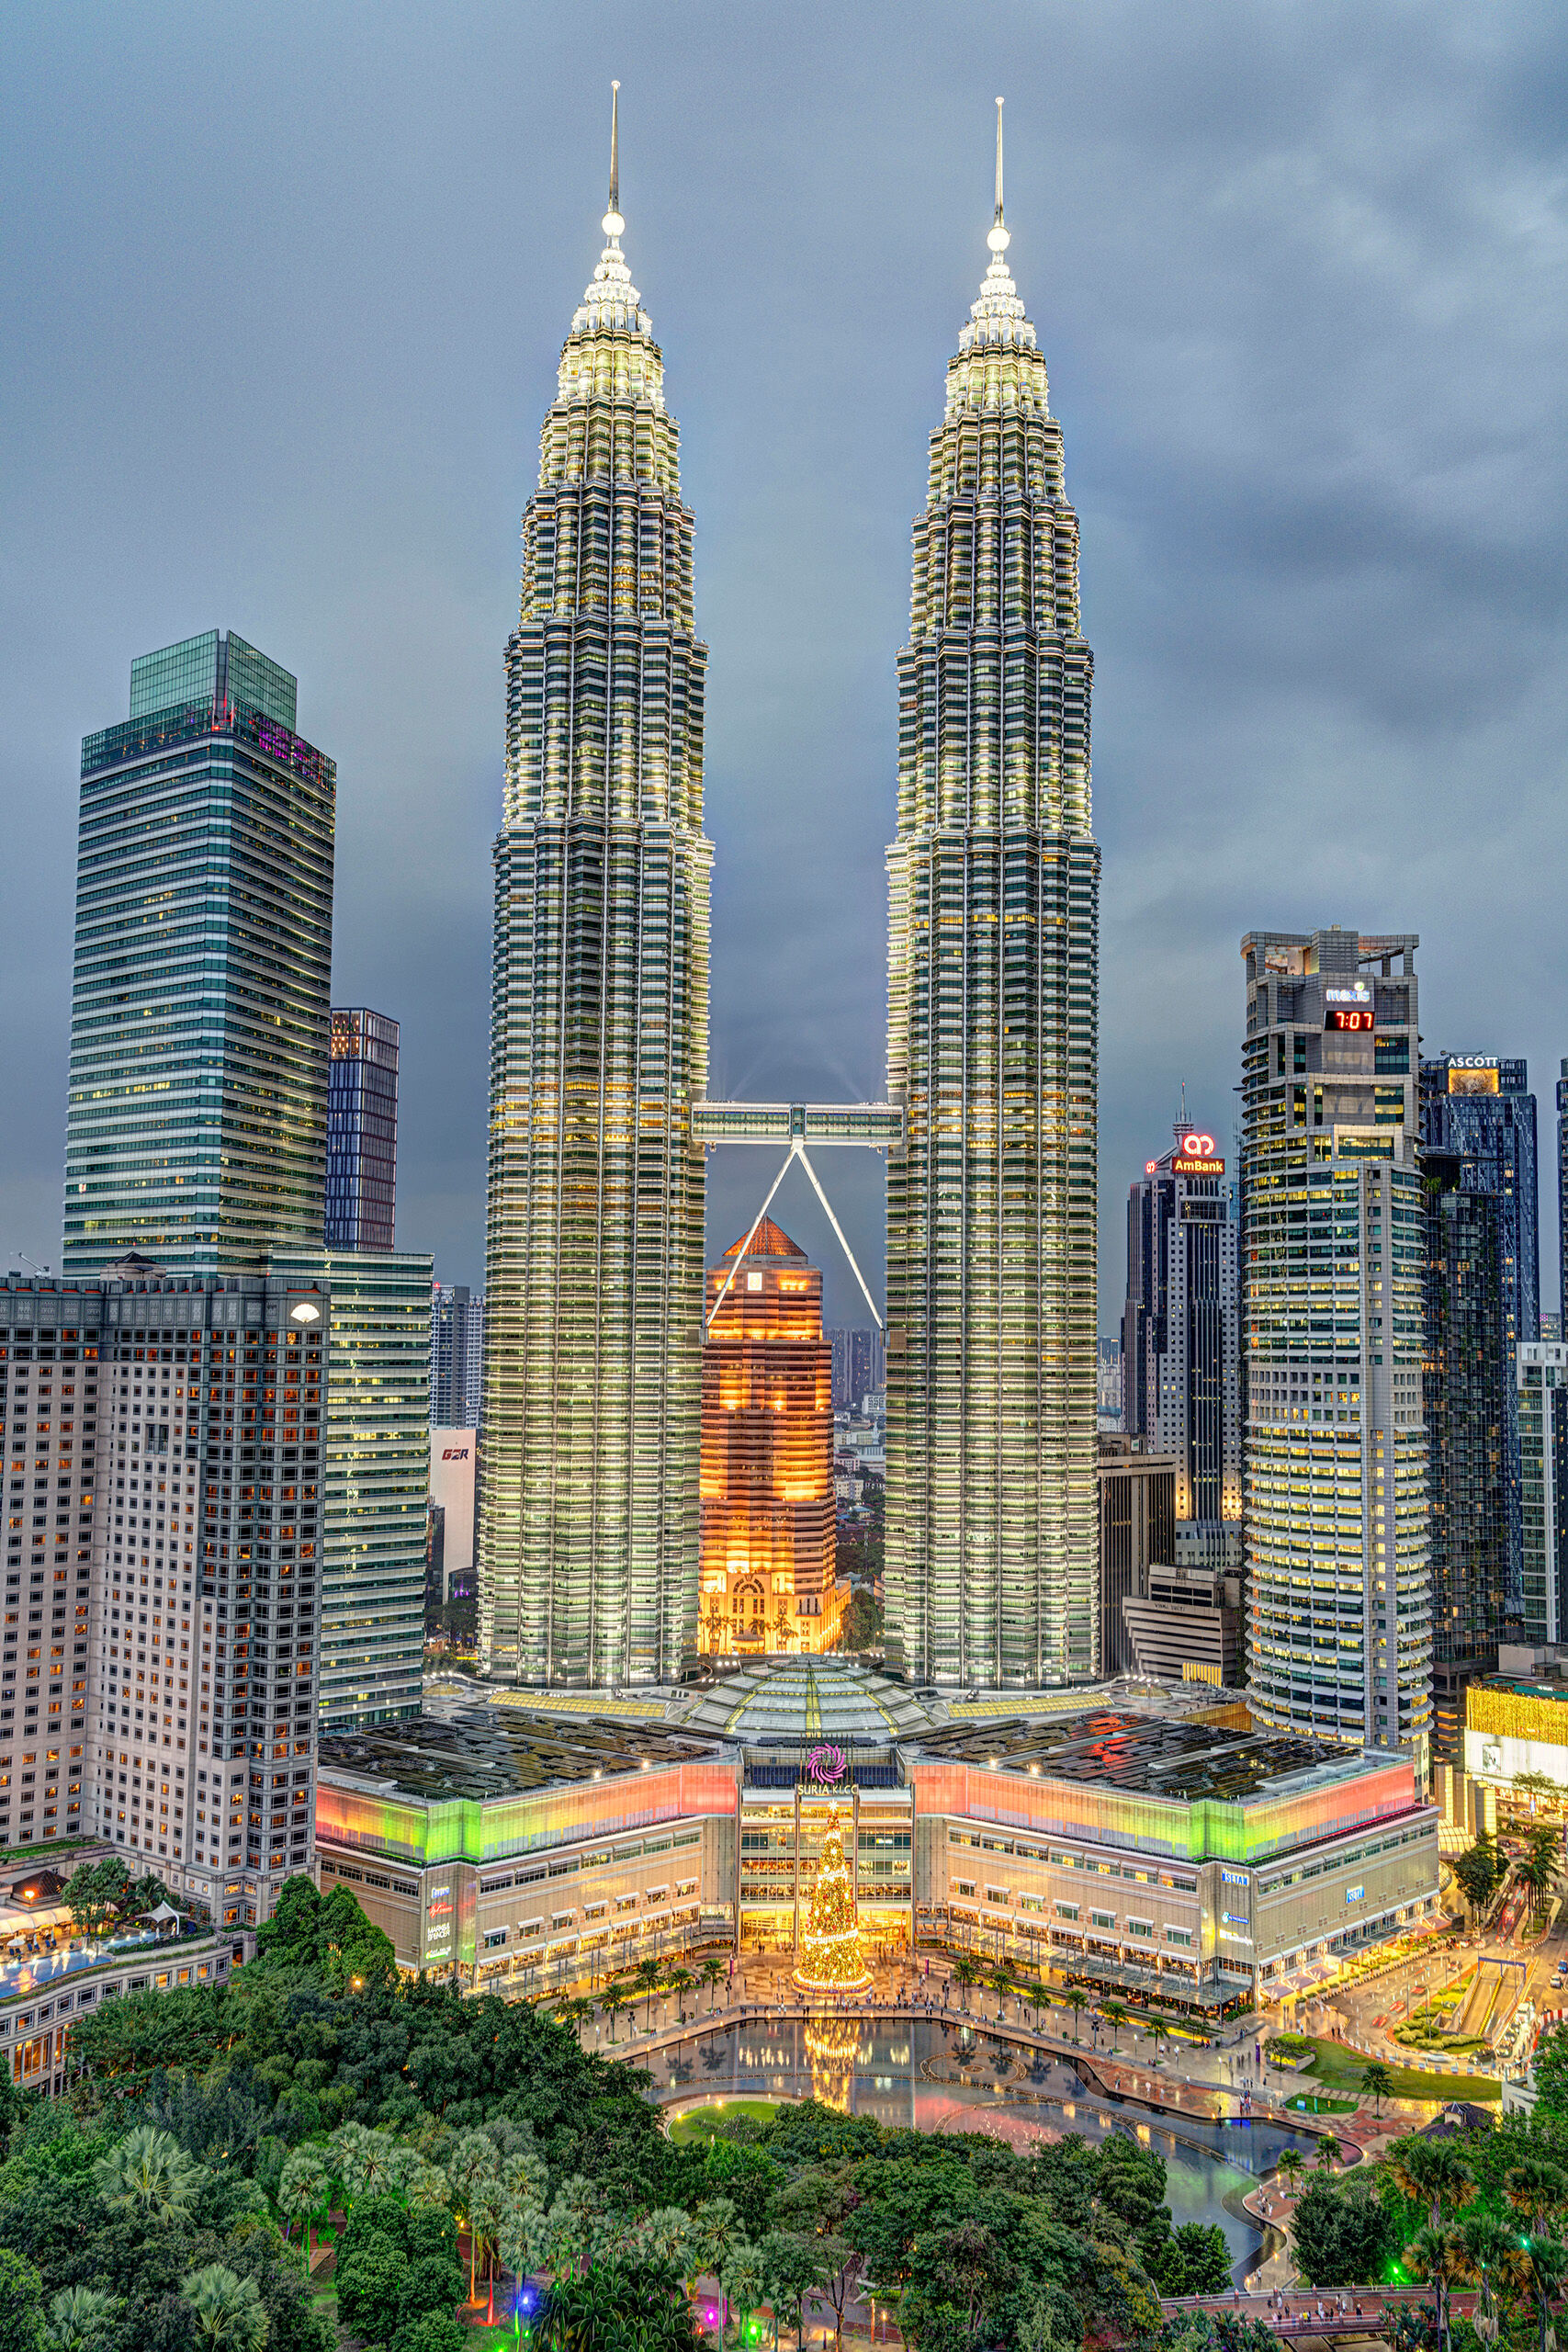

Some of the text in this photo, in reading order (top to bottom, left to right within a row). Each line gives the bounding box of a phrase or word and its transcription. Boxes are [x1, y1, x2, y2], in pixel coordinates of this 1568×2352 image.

[1325, 981, 1371, 1002] maxis
[1337, 1012, 1372, 1029] 7:07
[1448, 1057, 1498, 1068] ASCOTT
[1175, 1159, 1224, 1172] AmBank
[797, 1783, 859, 1795] SURIA KLCC
